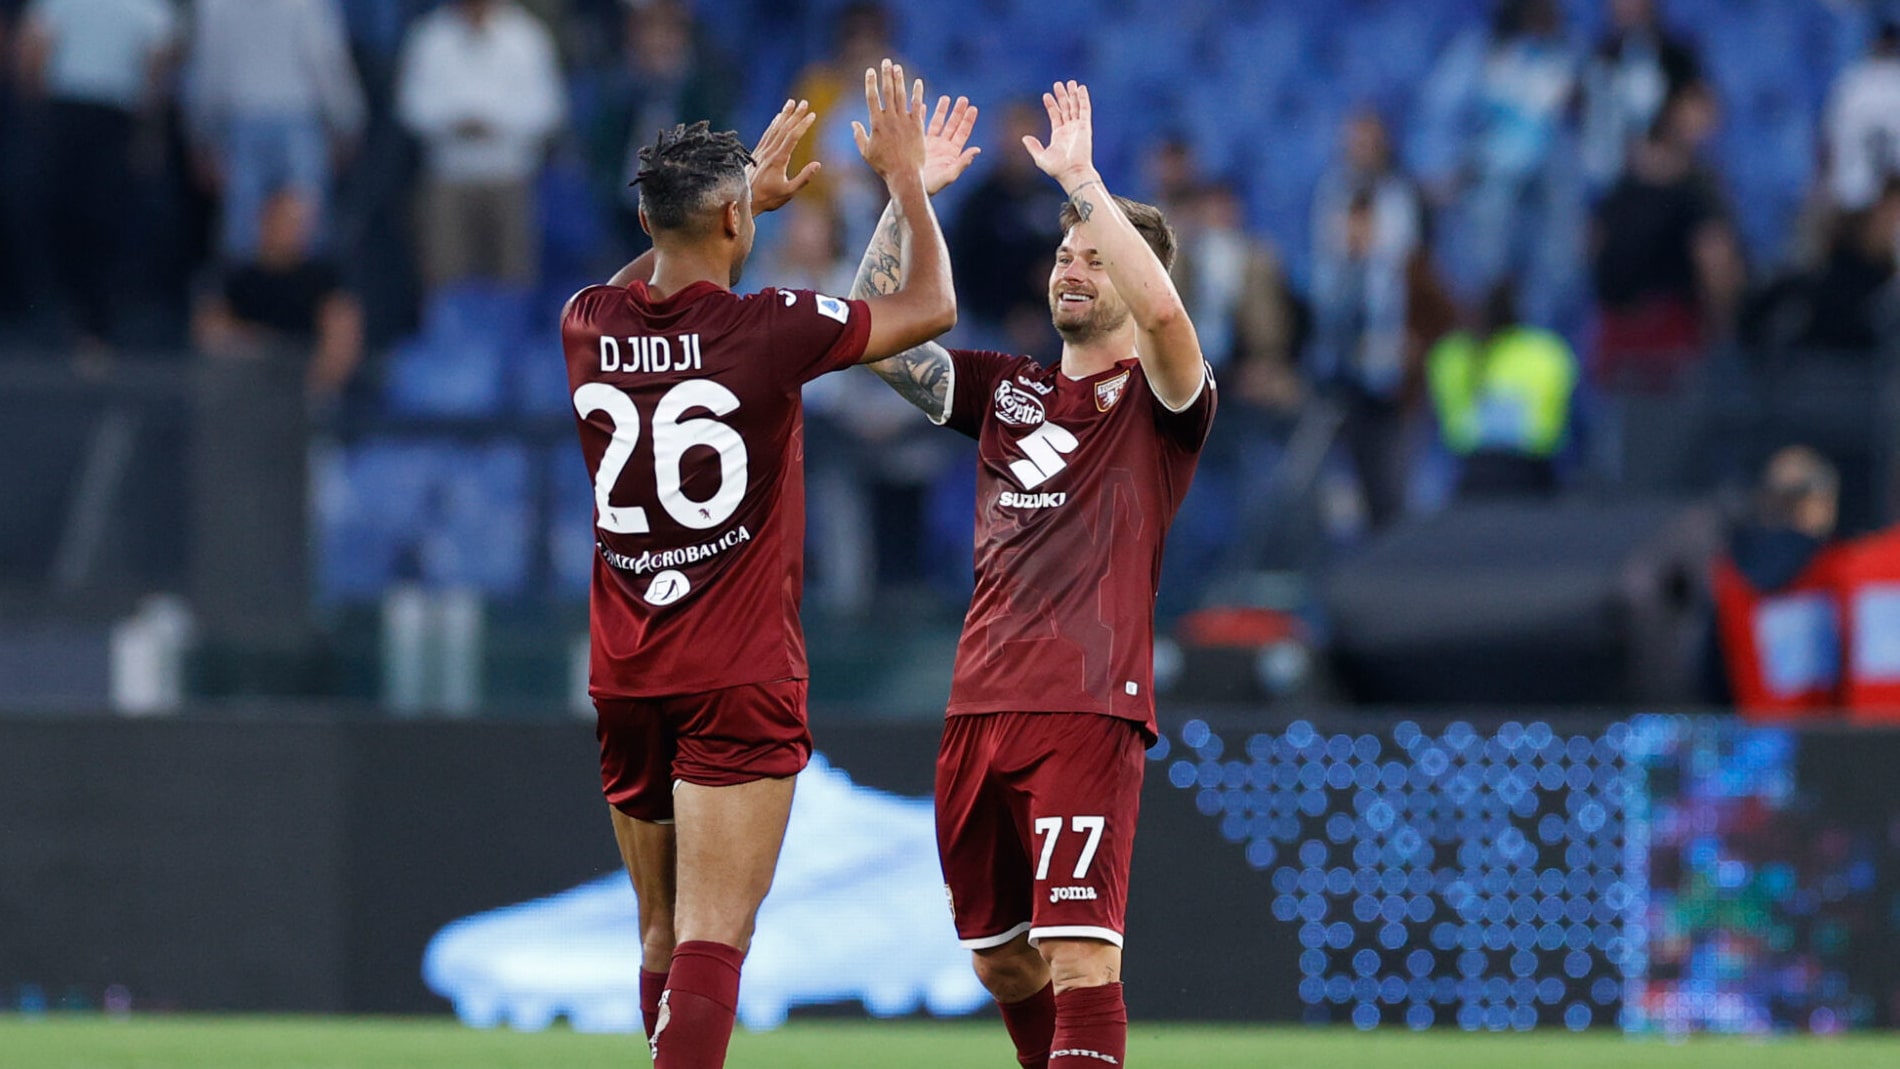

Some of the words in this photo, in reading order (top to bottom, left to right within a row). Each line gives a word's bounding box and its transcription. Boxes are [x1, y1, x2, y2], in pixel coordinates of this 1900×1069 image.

[600, 334, 702, 373] DJIDJI
[573, 379, 748, 534] 26
[999, 491, 1067, 509] SUZUKI
[1035, 816, 1105, 881] 77
